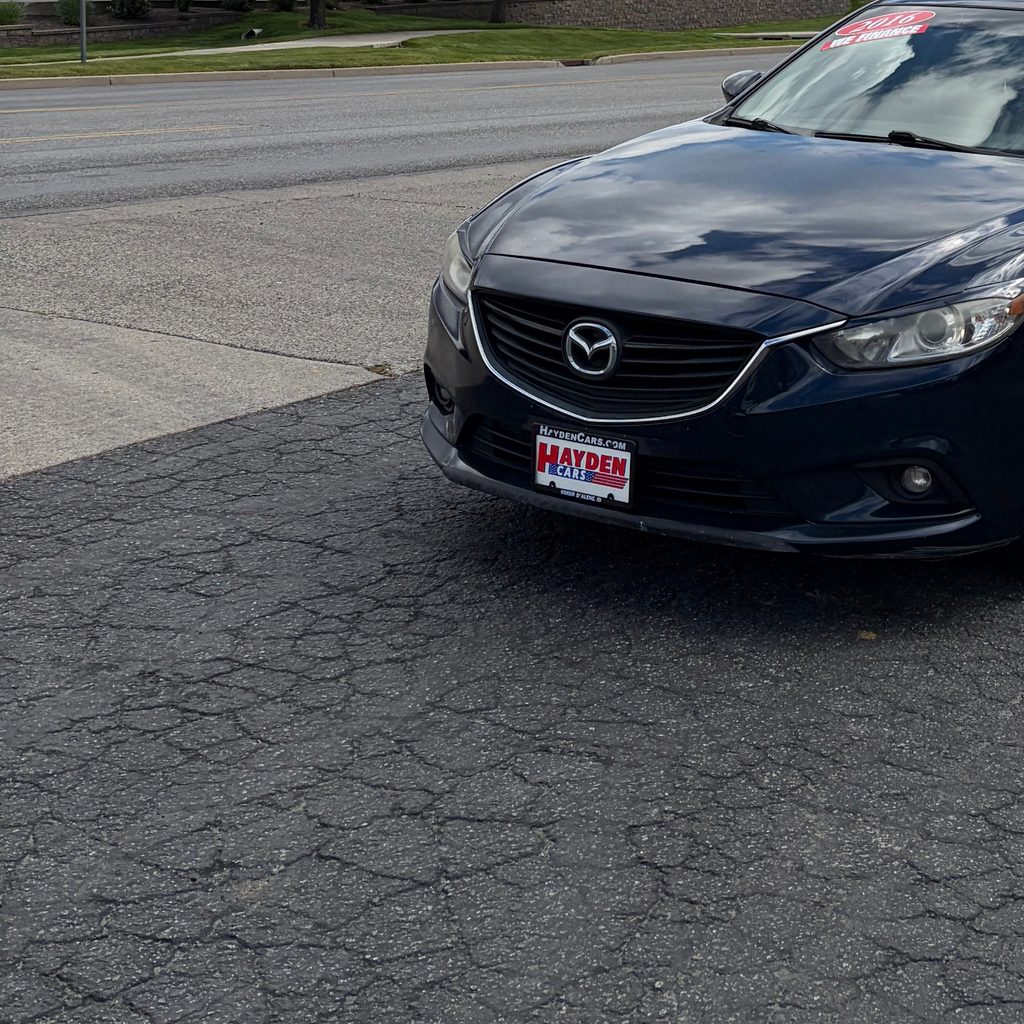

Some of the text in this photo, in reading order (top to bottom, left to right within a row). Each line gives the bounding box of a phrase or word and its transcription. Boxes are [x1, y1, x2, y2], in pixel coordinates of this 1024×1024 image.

[848, 14, 915, 35] 2016
[829, 24, 924, 48] WE FINANCE
[537, 442, 627, 476] HAYDEN
[556, 465, 587, 481] CARS
